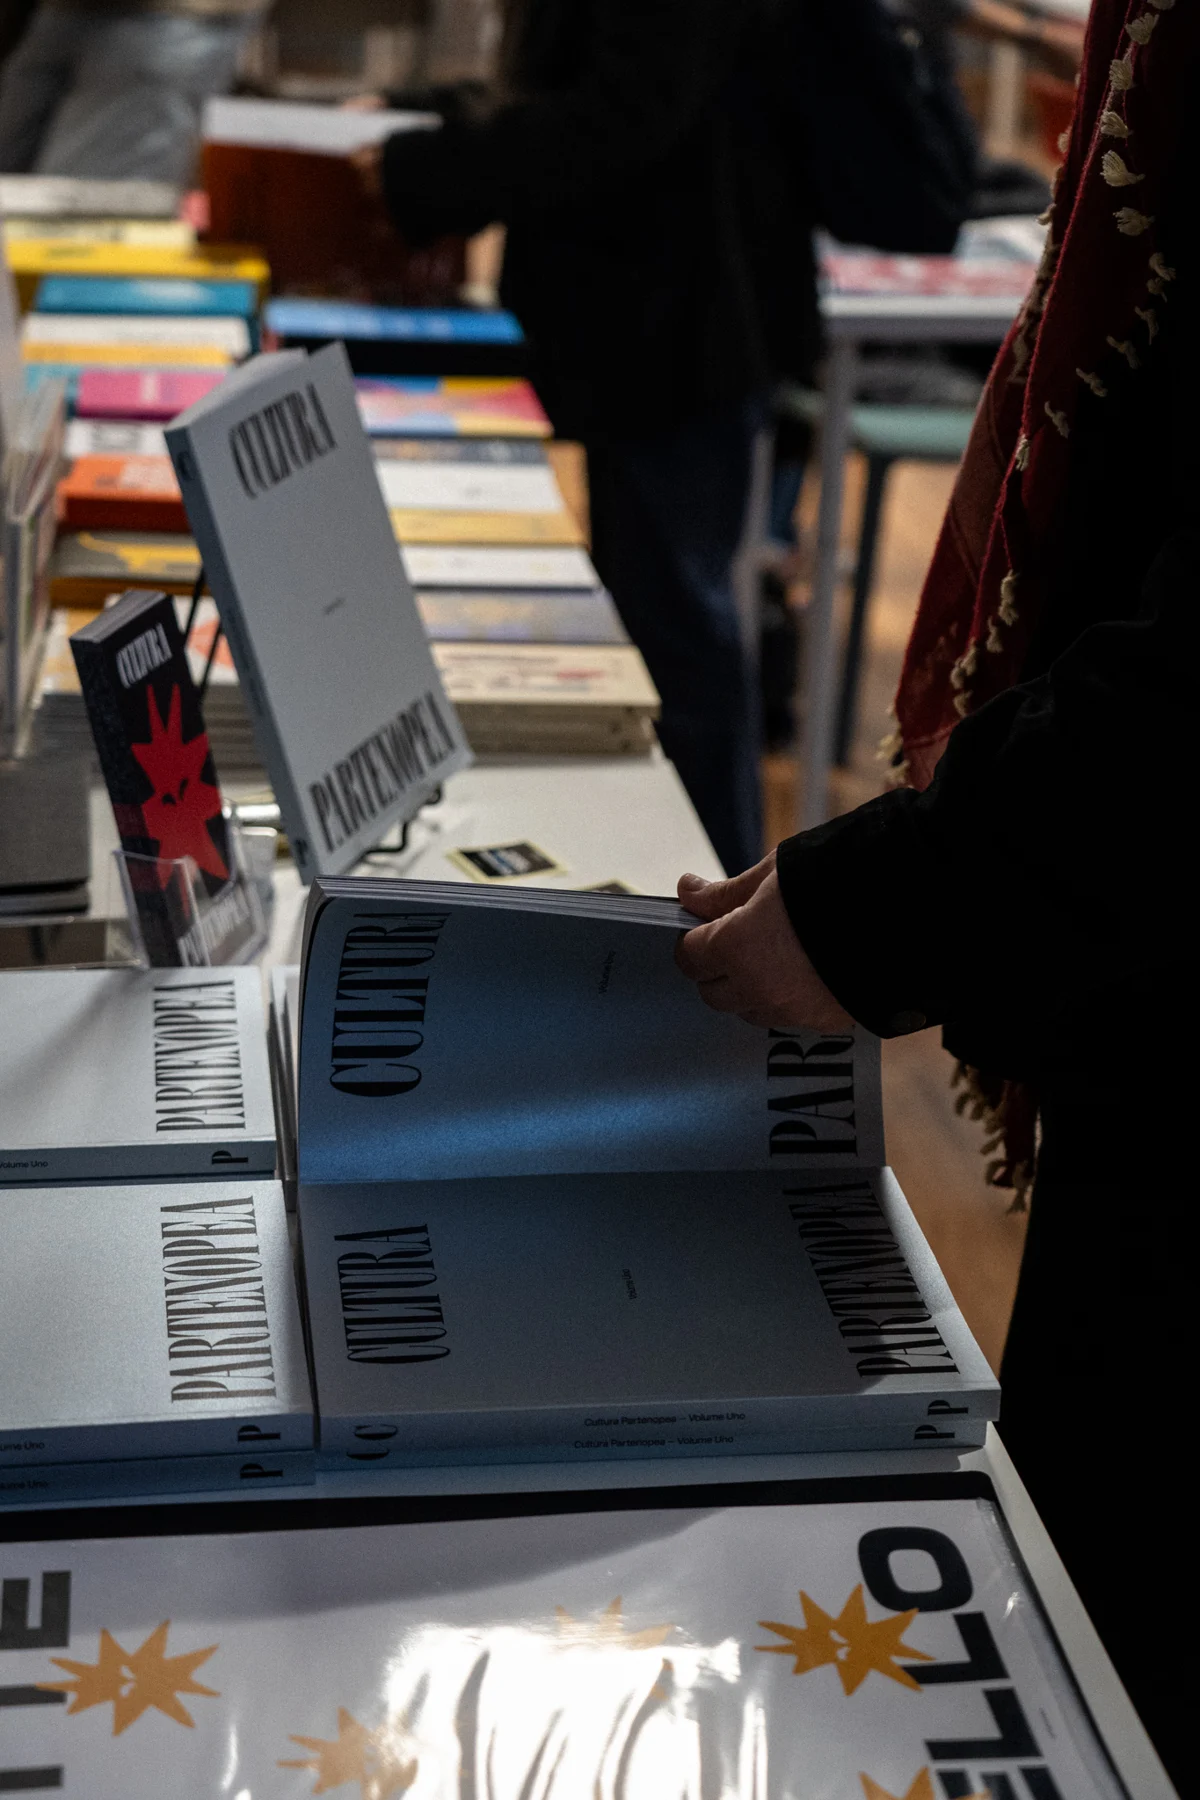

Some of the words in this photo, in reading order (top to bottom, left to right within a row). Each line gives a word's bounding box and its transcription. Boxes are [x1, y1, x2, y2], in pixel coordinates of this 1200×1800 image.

[330, 912, 452, 1097] CULTURA
[153, 979, 246, 1133] PARTENOPEA
[767, 1028, 858, 1158] PAR
[31, 1160, 49, 1168] Uno
[211, 1150, 248, 1165] P
[782, 1180, 960, 1378] PARTENOPEA
[160, 1195, 277, 1403] PARTENOPEA
[333, 1223, 450, 1365] CULTURA
[927, 1400, 968, 1416] P
[584, 1417, 619, 1427] Cultura
[621, 1415, 677, 1426] Partenopea
[688, 1412, 724, 1422] Volume
[726, 1412, 746, 1421] Uno
[237, 1425, 281, 1442] P
[354, 1423, 398, 1441] C
[914, 1425, 955, 1440] P
[574, 1439, 609, 1449] Cultura
[611, 1438, 666, 1448] Partenopea
[677, 1436, 713, 1445] Volume
[714, 1435, 734, 1444] Uno
[240, 1463, 283, 1479] P
